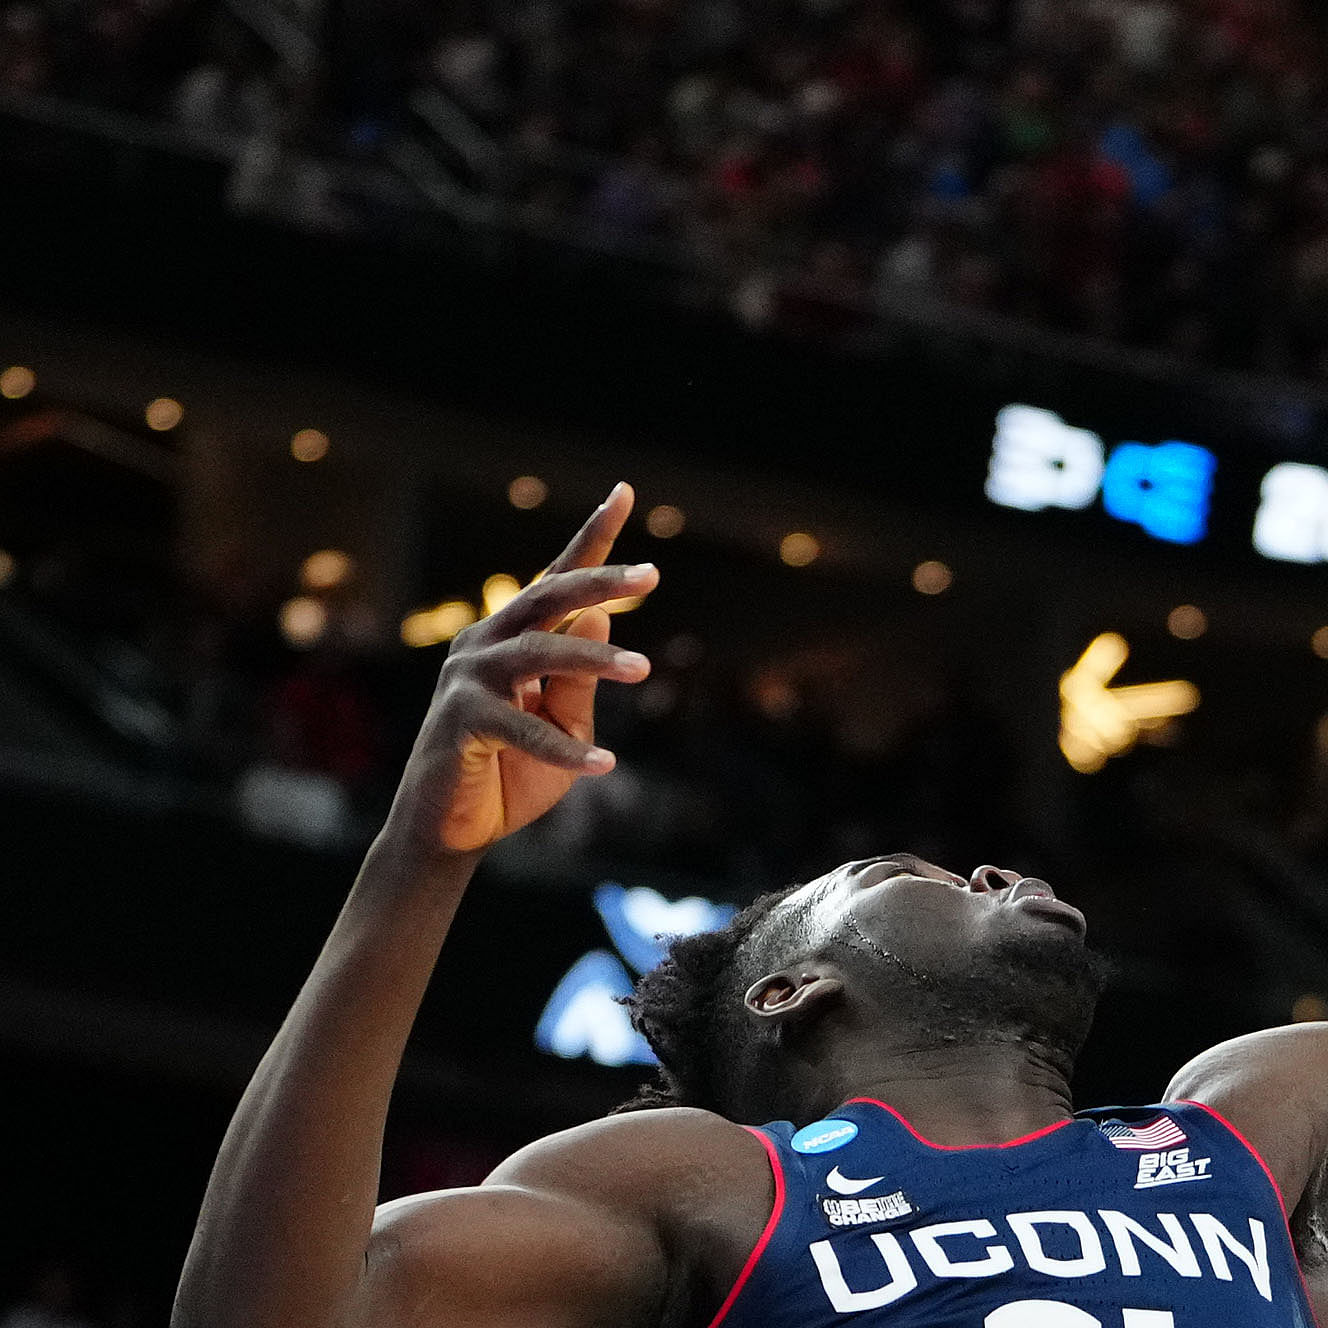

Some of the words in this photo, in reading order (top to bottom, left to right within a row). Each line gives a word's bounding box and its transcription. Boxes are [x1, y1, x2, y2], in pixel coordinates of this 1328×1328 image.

[1136, 1158, 1212, 1183] EAST
[1139, 1148, 1190, 1169] BIG
[810, 1209, 1273, 1313] UCONN
